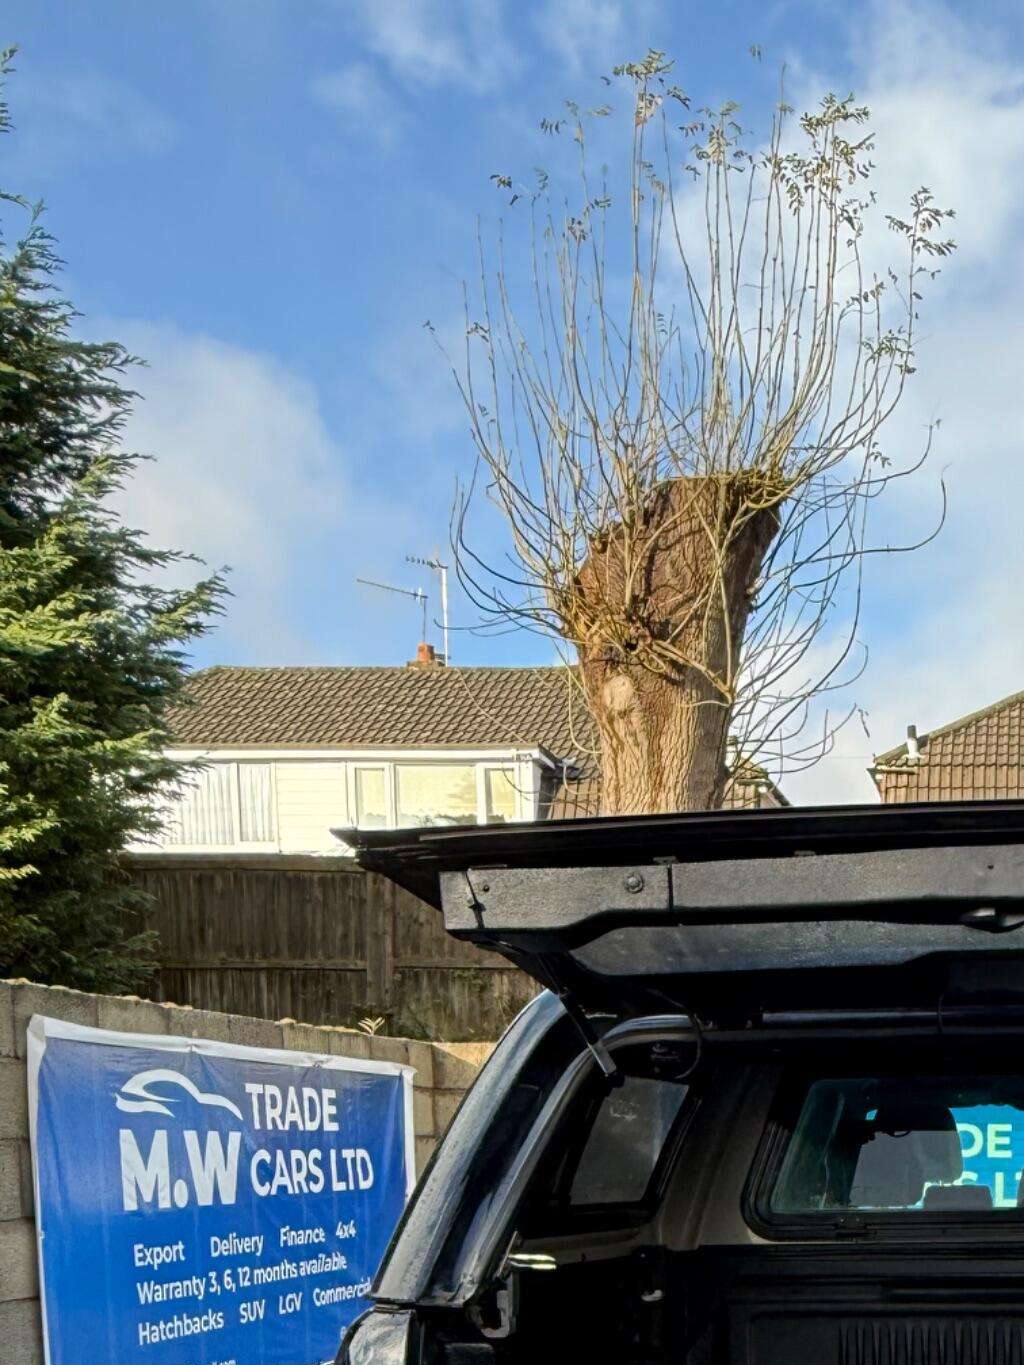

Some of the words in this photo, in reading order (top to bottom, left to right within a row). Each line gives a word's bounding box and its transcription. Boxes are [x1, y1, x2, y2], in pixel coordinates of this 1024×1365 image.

[244, 1083, 340, 1132] TRADE
[119, 1128, 242, 1211] M.W
[251, 1149, 326, 1197] CARS
[329, 1148, 375, 1192] LTD
[133, 1240, 185, 1271] Export
[210, 1232, 264, 1258] Delivery
[280, 1225, 326, 1248] Finance
[335, 1220, 357, 1239] 4x4
[136, 1276, 206, 1305] Warranty
[208, 1271, 222, 1295] 3,
[223, 1268, 237, 1293] 6,
[237, 1266, 252, 1288] 12
[253, 1259, 298, 1285] months
[299, 1252, 348, 1277] available
[138, 1309, 225, 1346] Hatchbacks
[239, 1299, 265, 1324] SUV
[278, 1292, 303, 1315] LGV
